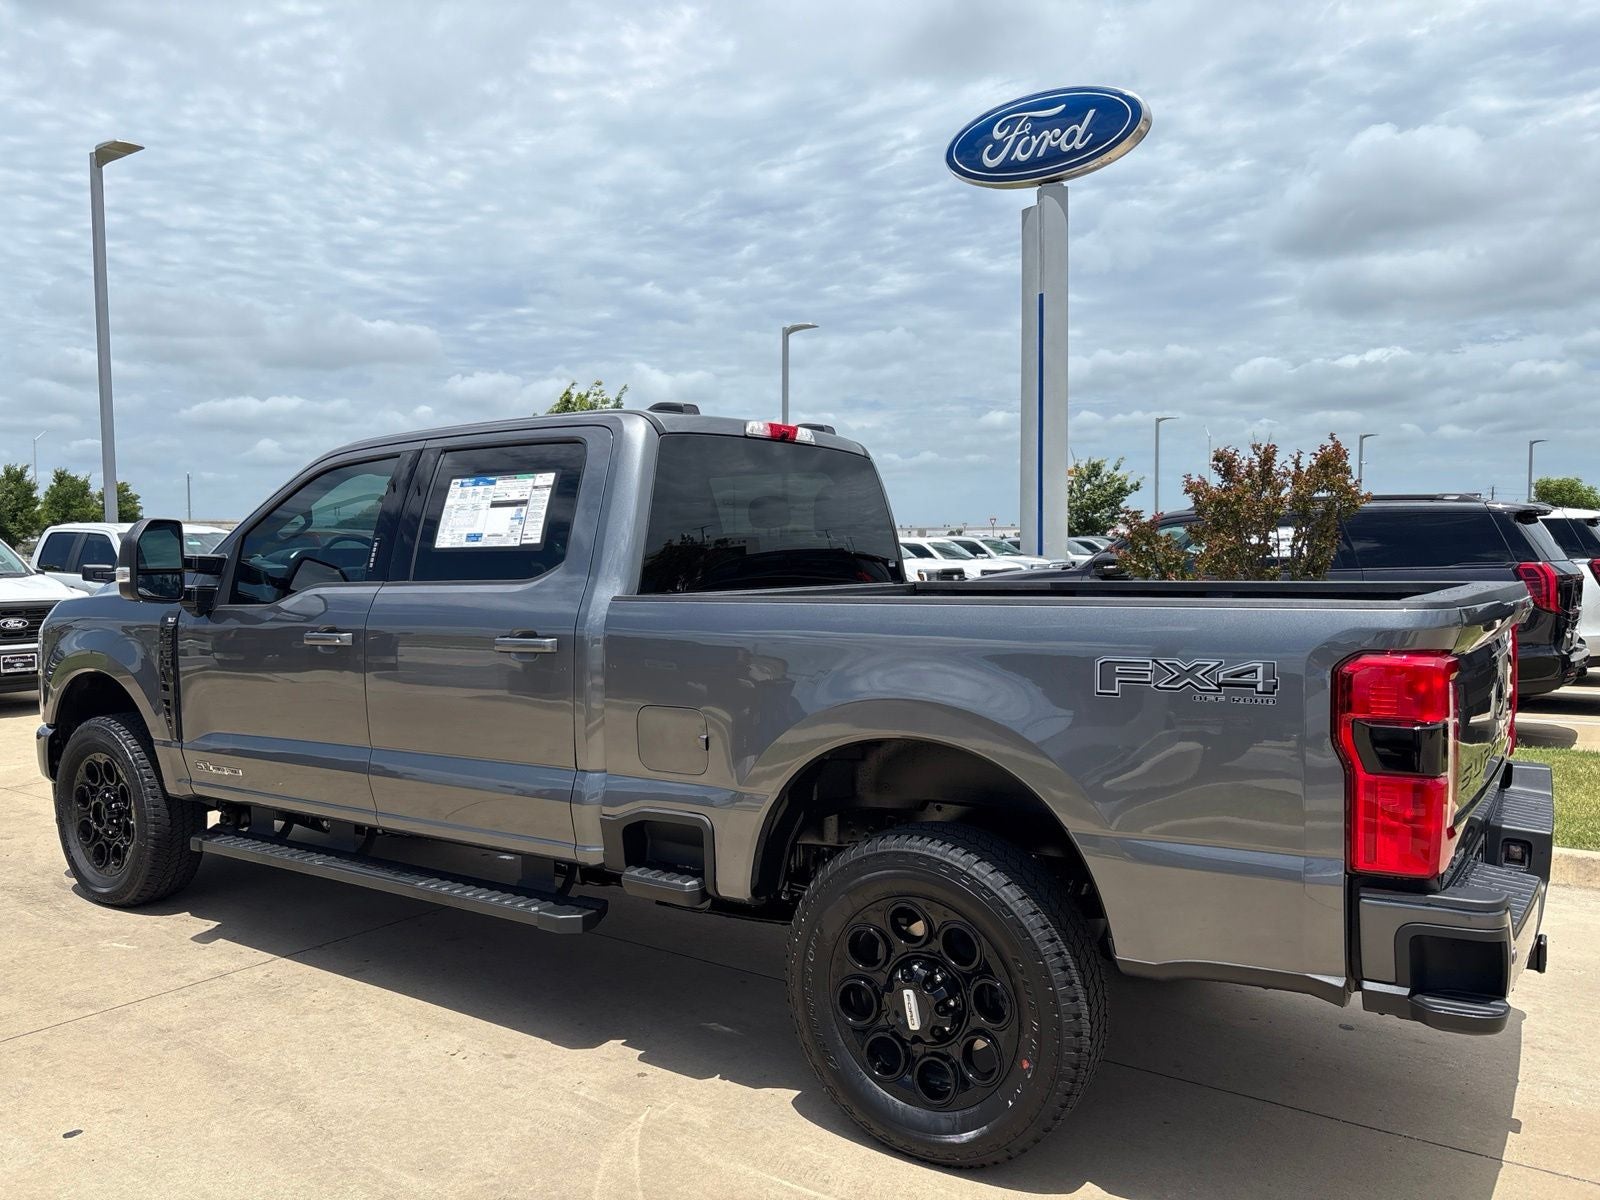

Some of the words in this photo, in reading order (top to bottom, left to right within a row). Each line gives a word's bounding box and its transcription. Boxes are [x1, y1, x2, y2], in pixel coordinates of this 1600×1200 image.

[982, 103, 1096, 168] Ford
[1095, 656, 1279, 697] FX4
[1192, 694, 1225, 702] OFF
[1231, 696, 1276, 705] ROAD
